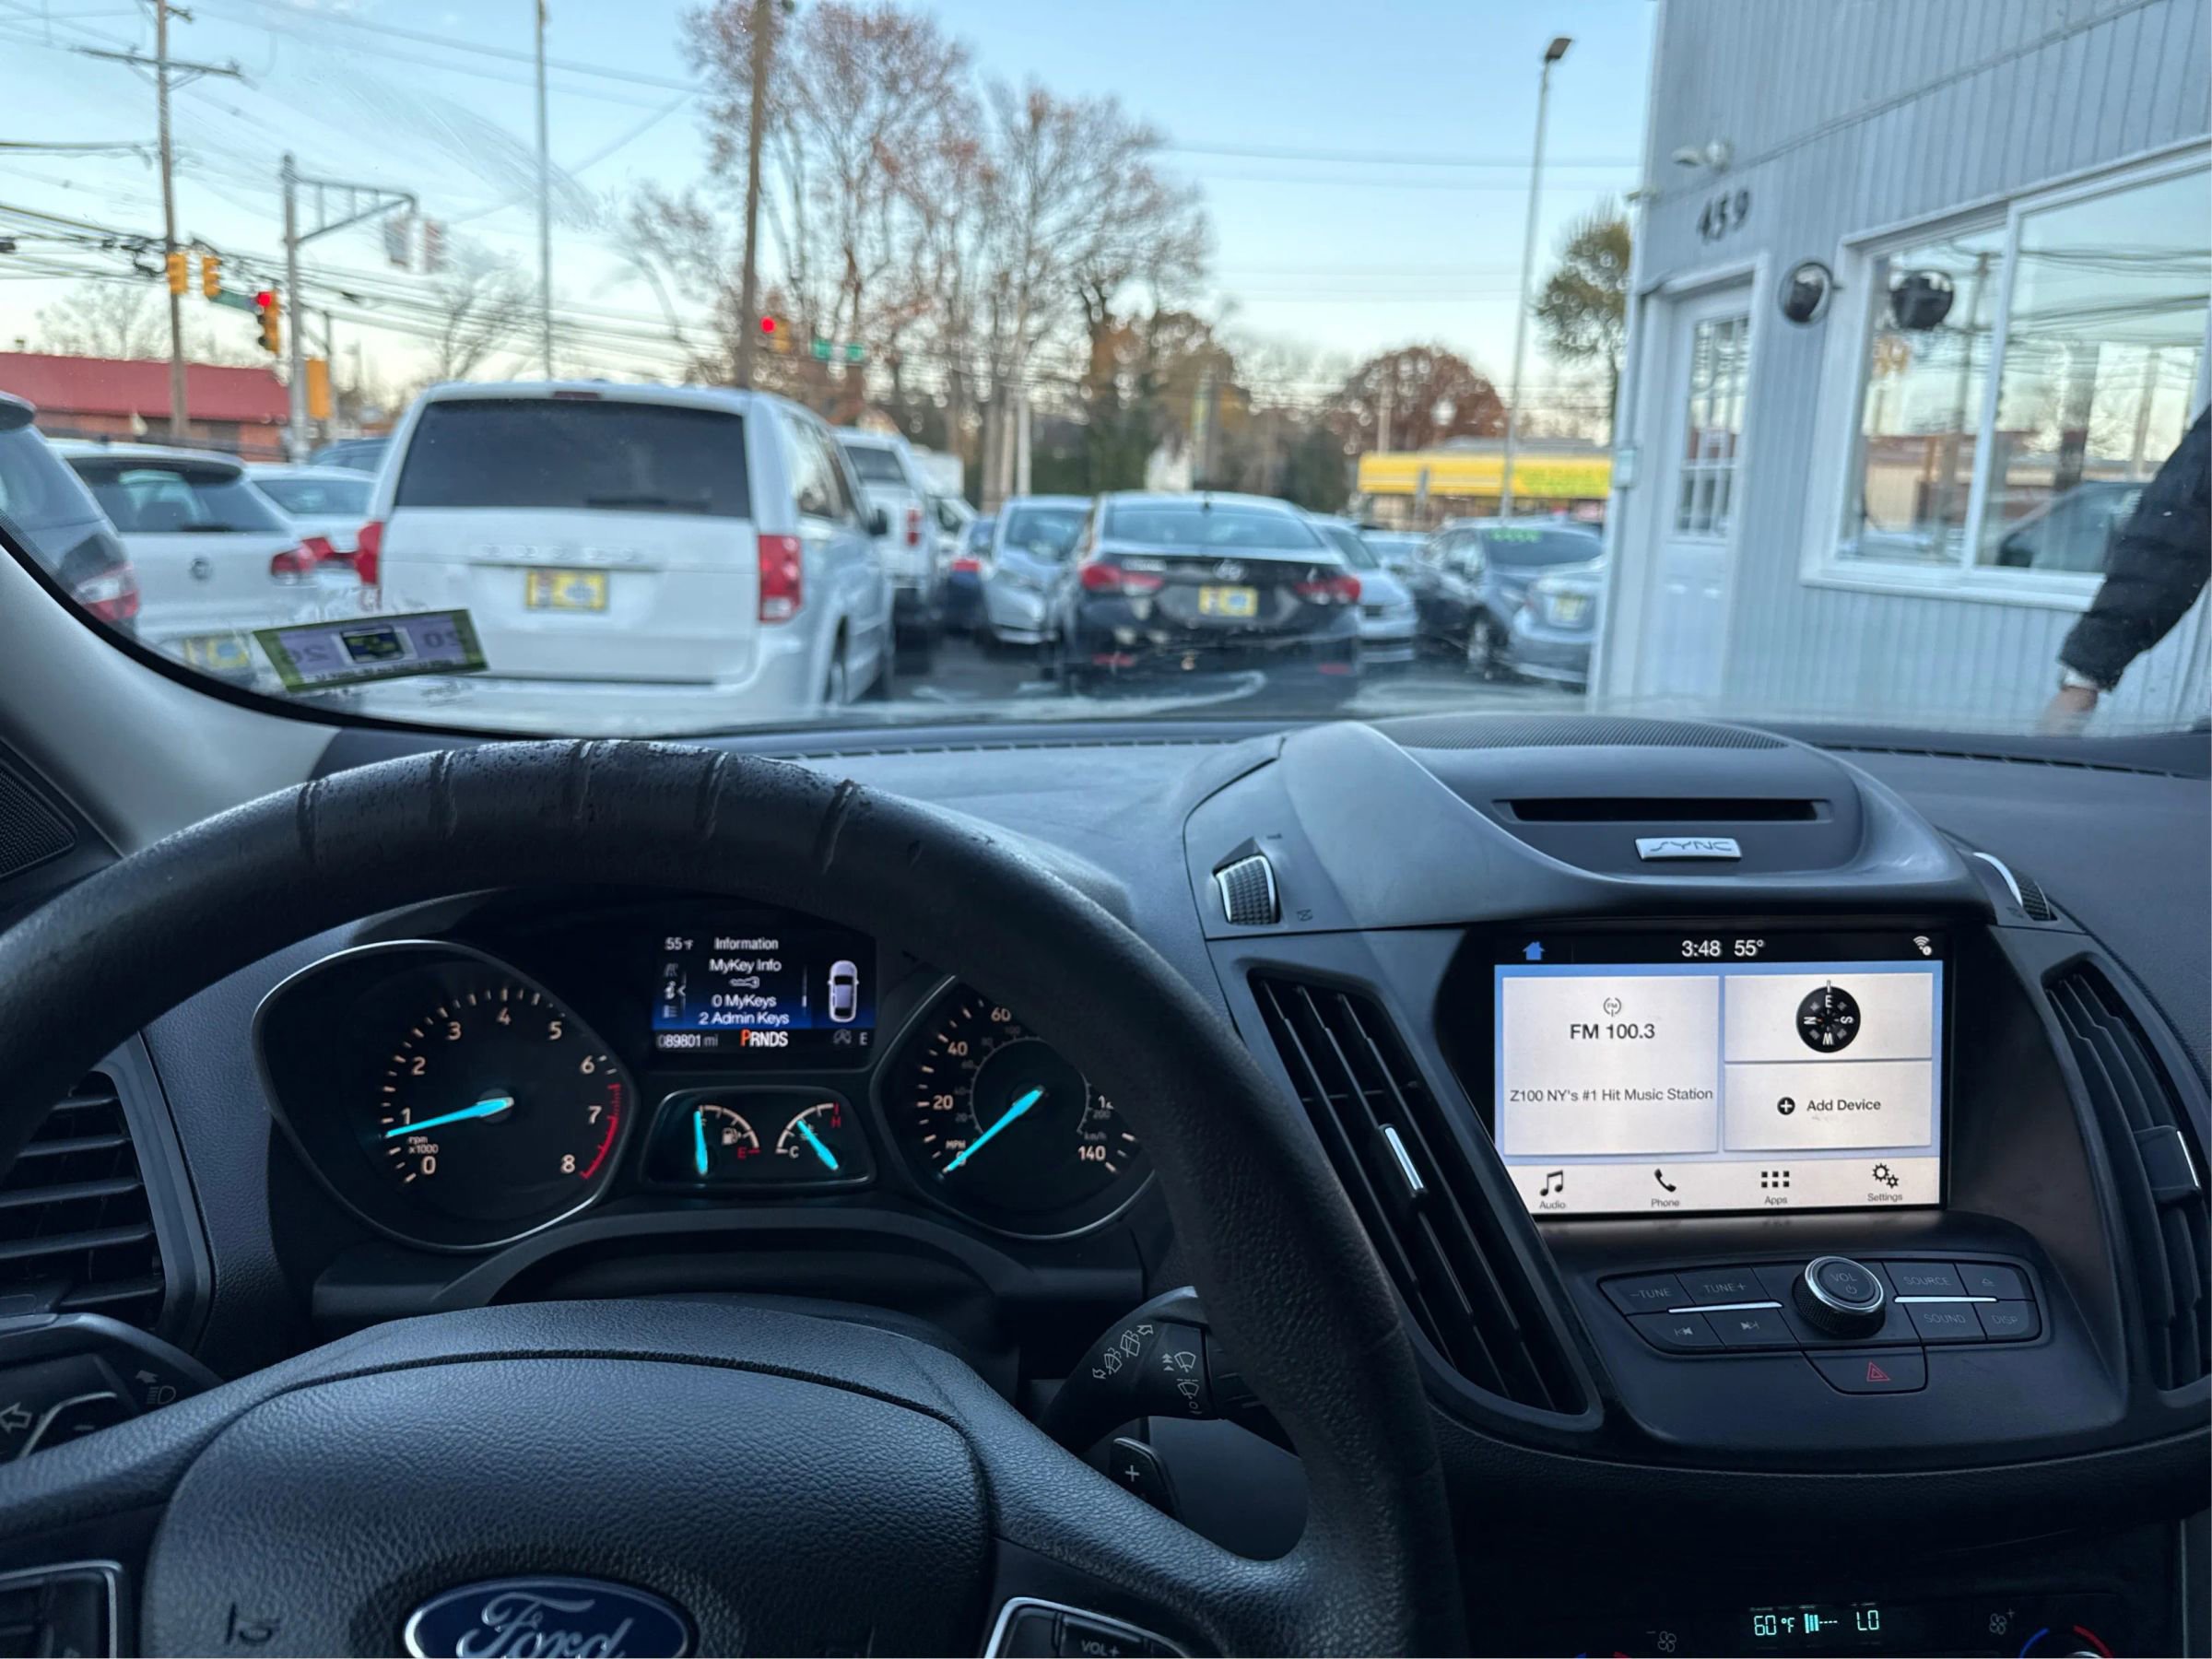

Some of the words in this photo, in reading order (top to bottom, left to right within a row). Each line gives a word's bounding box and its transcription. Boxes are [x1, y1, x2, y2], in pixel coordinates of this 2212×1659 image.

[1650, 840, 1733, 852] SYNC
[714, 937, 779, 950] Information
[1682, 940, 1721, 957] 3:48
[1735, 939, 1764, 957] 55°
[710, 959, 754, 974] MyKey
[758, 959, 782, 971] Info
[724, 994, 776, 1011] MyKeys
[497, 1007, 511, 1025] 4
[699, 1013, 709, 1025] 2
[711, 1012, 755, 1025] Admin
[758, 1012, 789, 1029] Keys
[991, 1006, 1012, 1022] 60
[447, 1021, 461, 1040] 3
[548, 1021, 562, 1040] 5
[1570, 1023, 1599, 1040] FM
[1606, 1023, 1655, 1040] 100.3
[657, 1034, 701, 1048] 089801
[947, 1041, 968, 1056] 40
[411, 1057, 426, 1075] 2
[580, 1055, 594, 1074] 6
[1510, 1089, 1544, 1101] Z100
[1547, 1089, 1579, 1101] NY's
[1583, 1089, 1597, 1100] #1
[1602, 1088, 1620, 1100] Hit
[1624, 1088, 1664, 1100] Music
[1666, 1088, 1712, 1100] Station
[933, 1095, 954, 1111] 20
[1806, 1099, 1832, 1111] Add
[1837, 1098, 1881, 1111] Device
[401, 1107, 411, 1125] 1
[588, 1105, 603, 1124] 7
[738, 1147, 747, 1159] E
[789, 1146, 800, 1159] C
[1078, 1146, 1107, 1161] 140
[423, 1156, 437, 1174] 0
[560, 1154, 576, 1173] 8
[1539, 1200, 1566, 1210] Audio
[1651, 1198, 1680, 1208] Phone
[1764, 1195, 1788, 1206] Apps
[1867, 1192, 1903, 1204] Settings
[1830, 1273, 1857, 1282] VOL
[1903, 1277, 1952, 1286] SOURCE
[1924, 1313, 1966, 1324] SOUND
[1991, 1314, 2018, 1324] DISP
